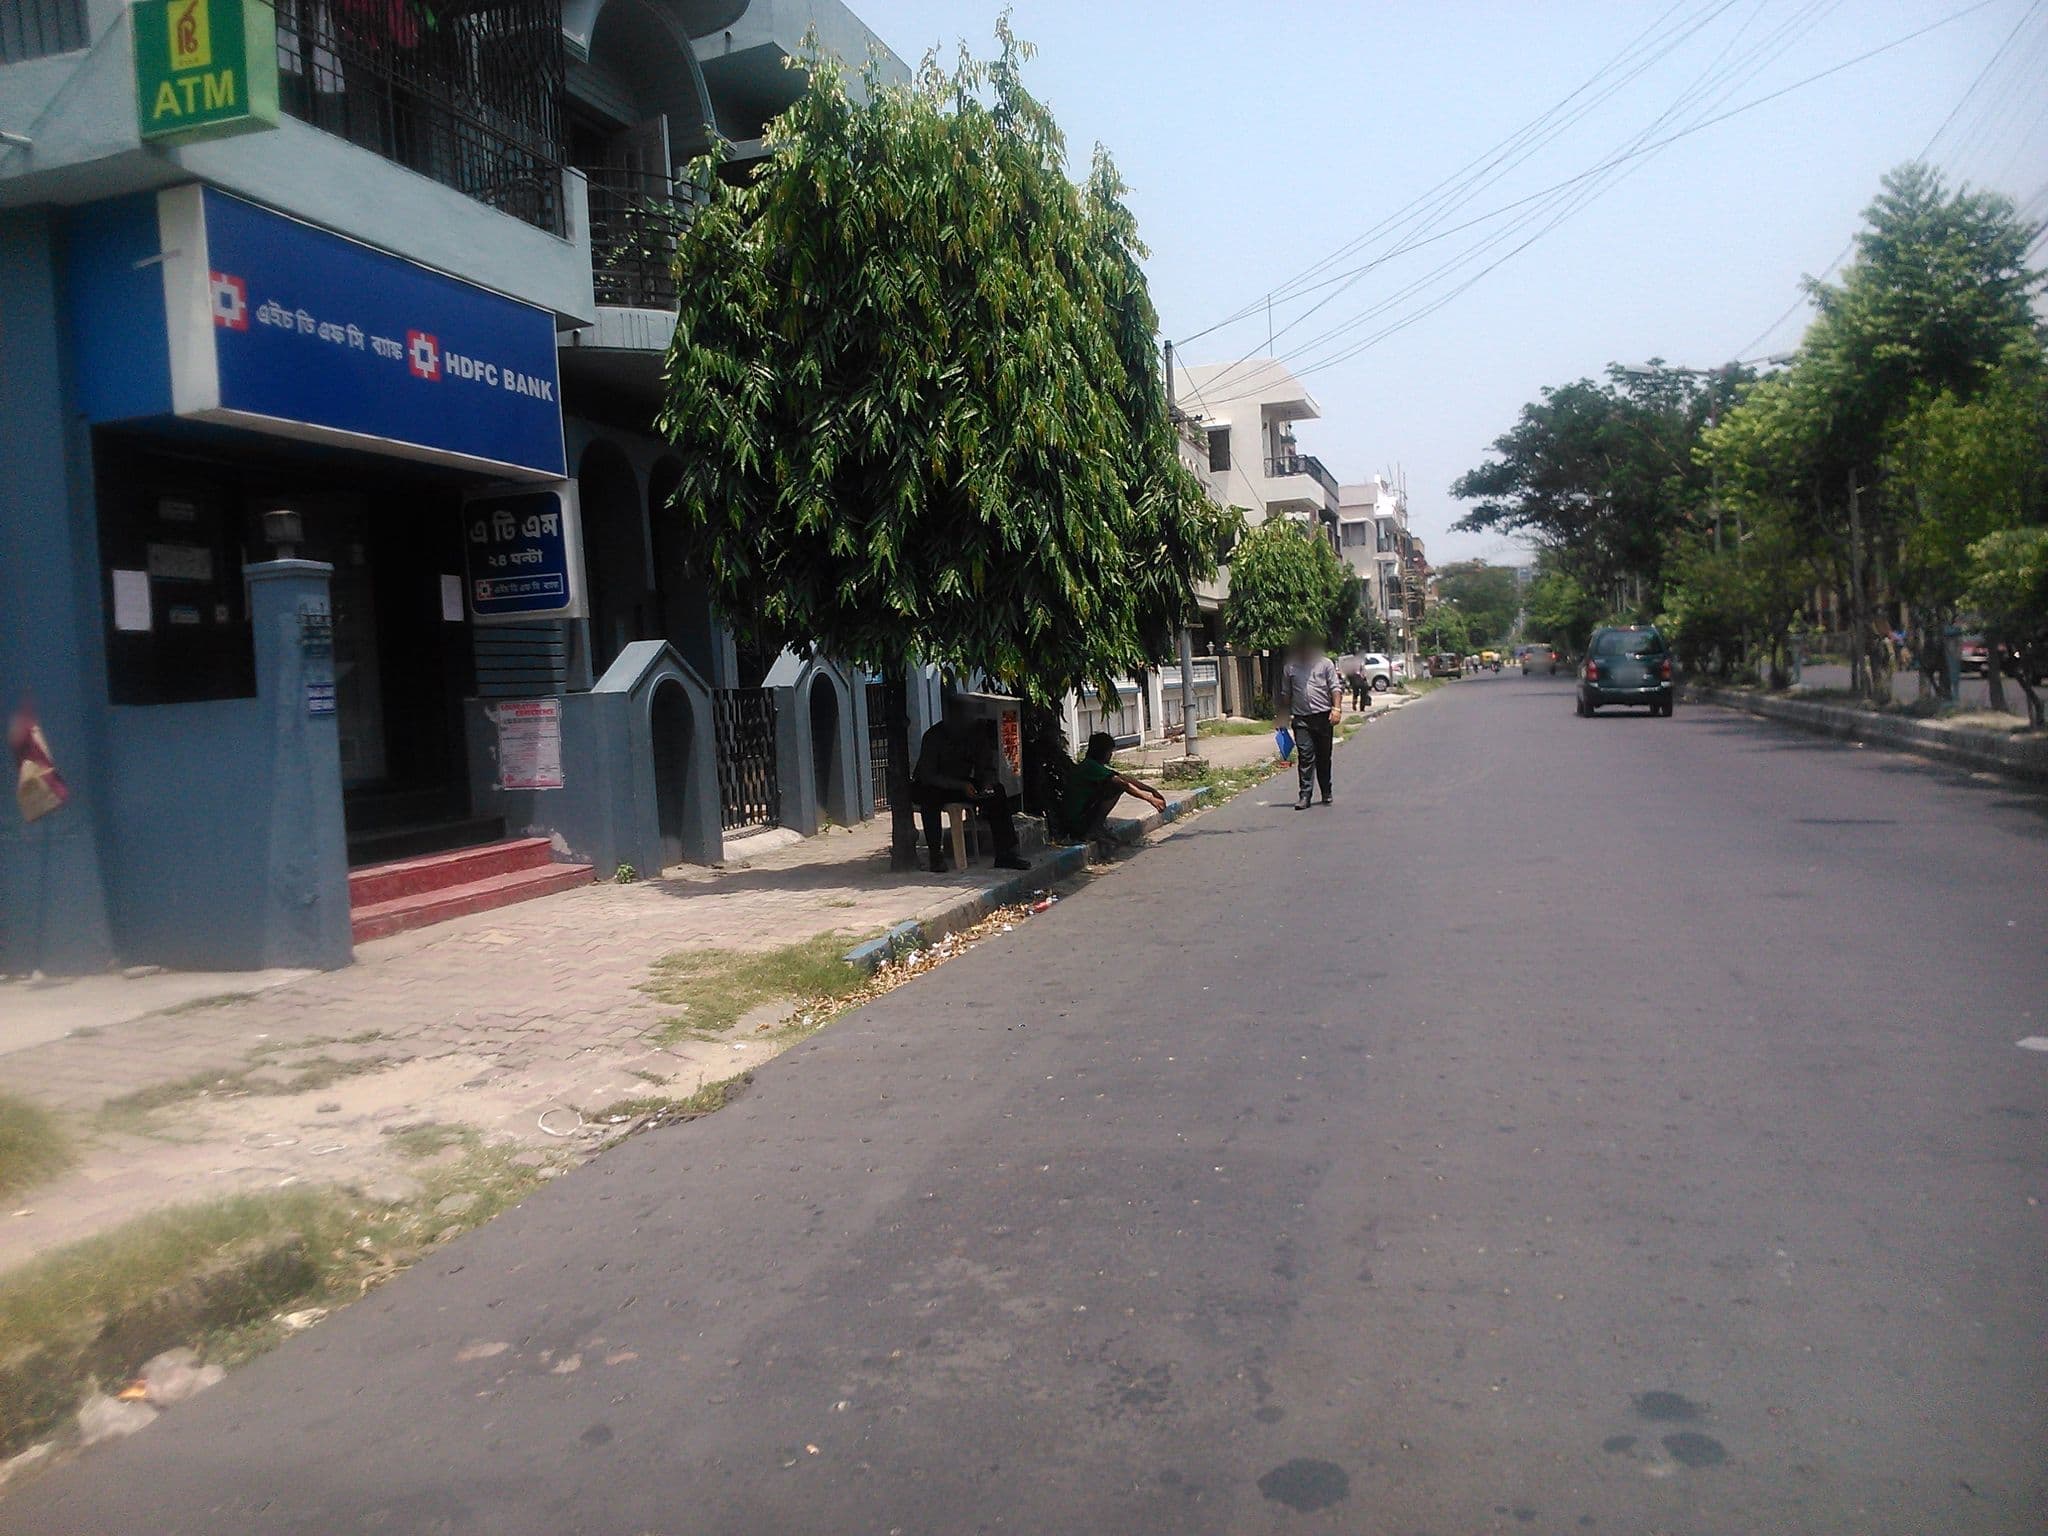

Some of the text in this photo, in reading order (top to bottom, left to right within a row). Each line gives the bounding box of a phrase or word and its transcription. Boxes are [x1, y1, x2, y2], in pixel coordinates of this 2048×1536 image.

[153, 70, 235, 119] ATM
[256, 299, 294, 329] এইচ
[295, 308, 316, 335] ডি
[317, 321, 346, 345] এফ
[346, 322, 365, 351] সি
[445, 351, 554, 402] HDFC BANK
[470, 510, 558, 544] এ টি এম
